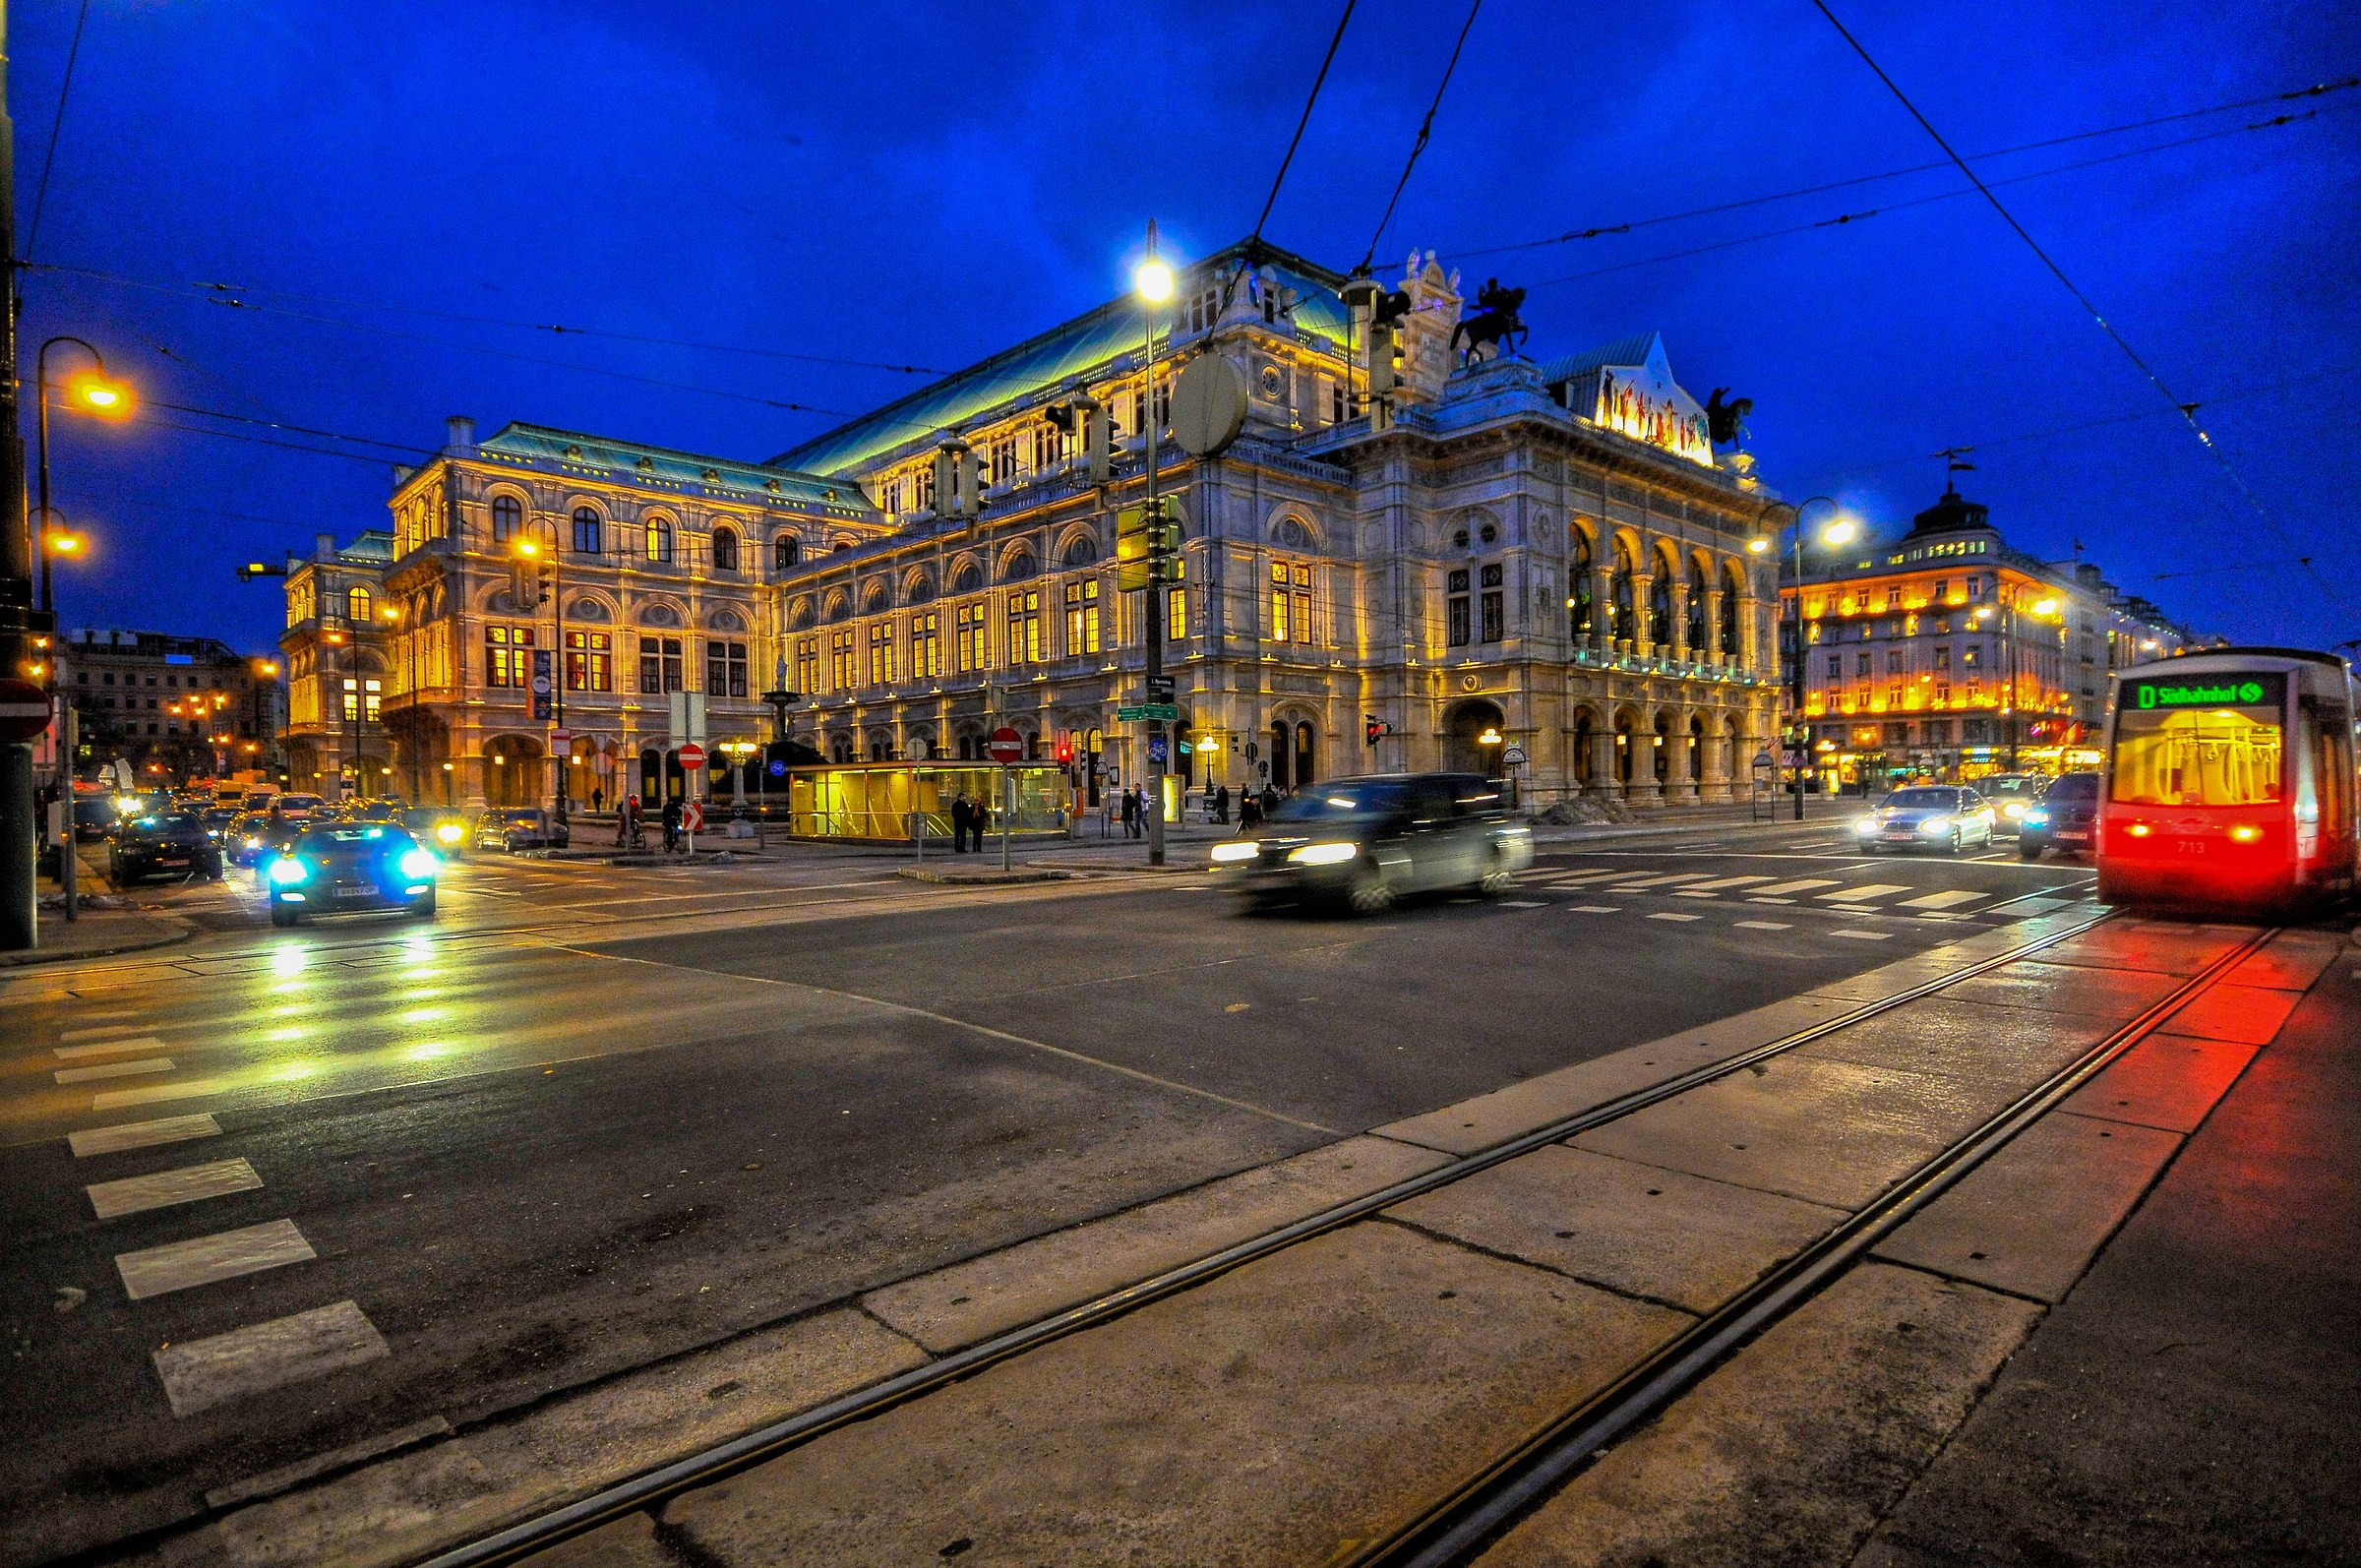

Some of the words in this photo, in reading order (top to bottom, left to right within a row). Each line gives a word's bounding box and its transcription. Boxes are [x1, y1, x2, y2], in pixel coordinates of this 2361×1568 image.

[2138, 686, 2156, 709] D
[2158, 685, 2237, 704] Südbahnhof
[2177, 841, 2206, 854] 713
